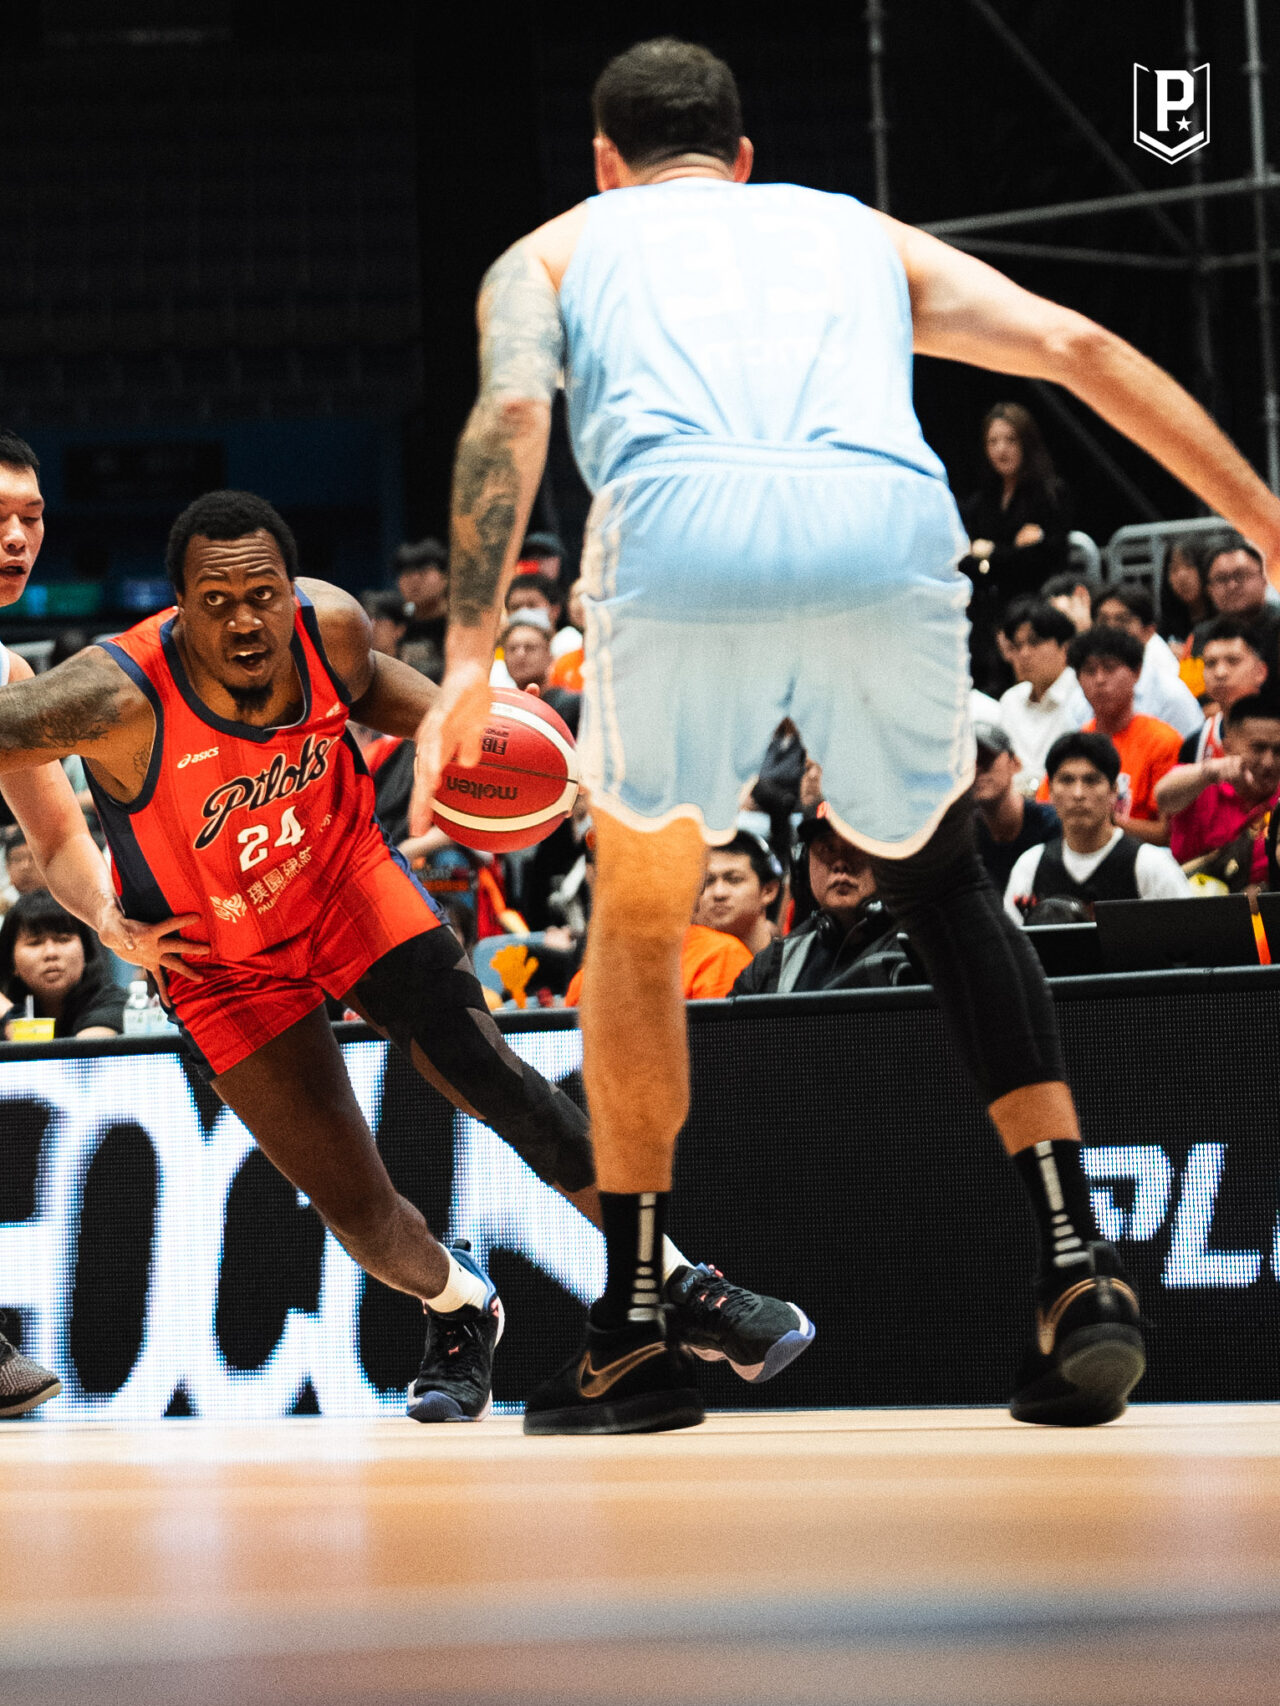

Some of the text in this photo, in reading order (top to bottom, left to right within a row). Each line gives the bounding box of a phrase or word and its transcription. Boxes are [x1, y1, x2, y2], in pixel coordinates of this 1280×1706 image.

[193, 733, 340, 849] Pilots
[446, 775, 518, 800] molten
[237, 805, 306, 873] 24
